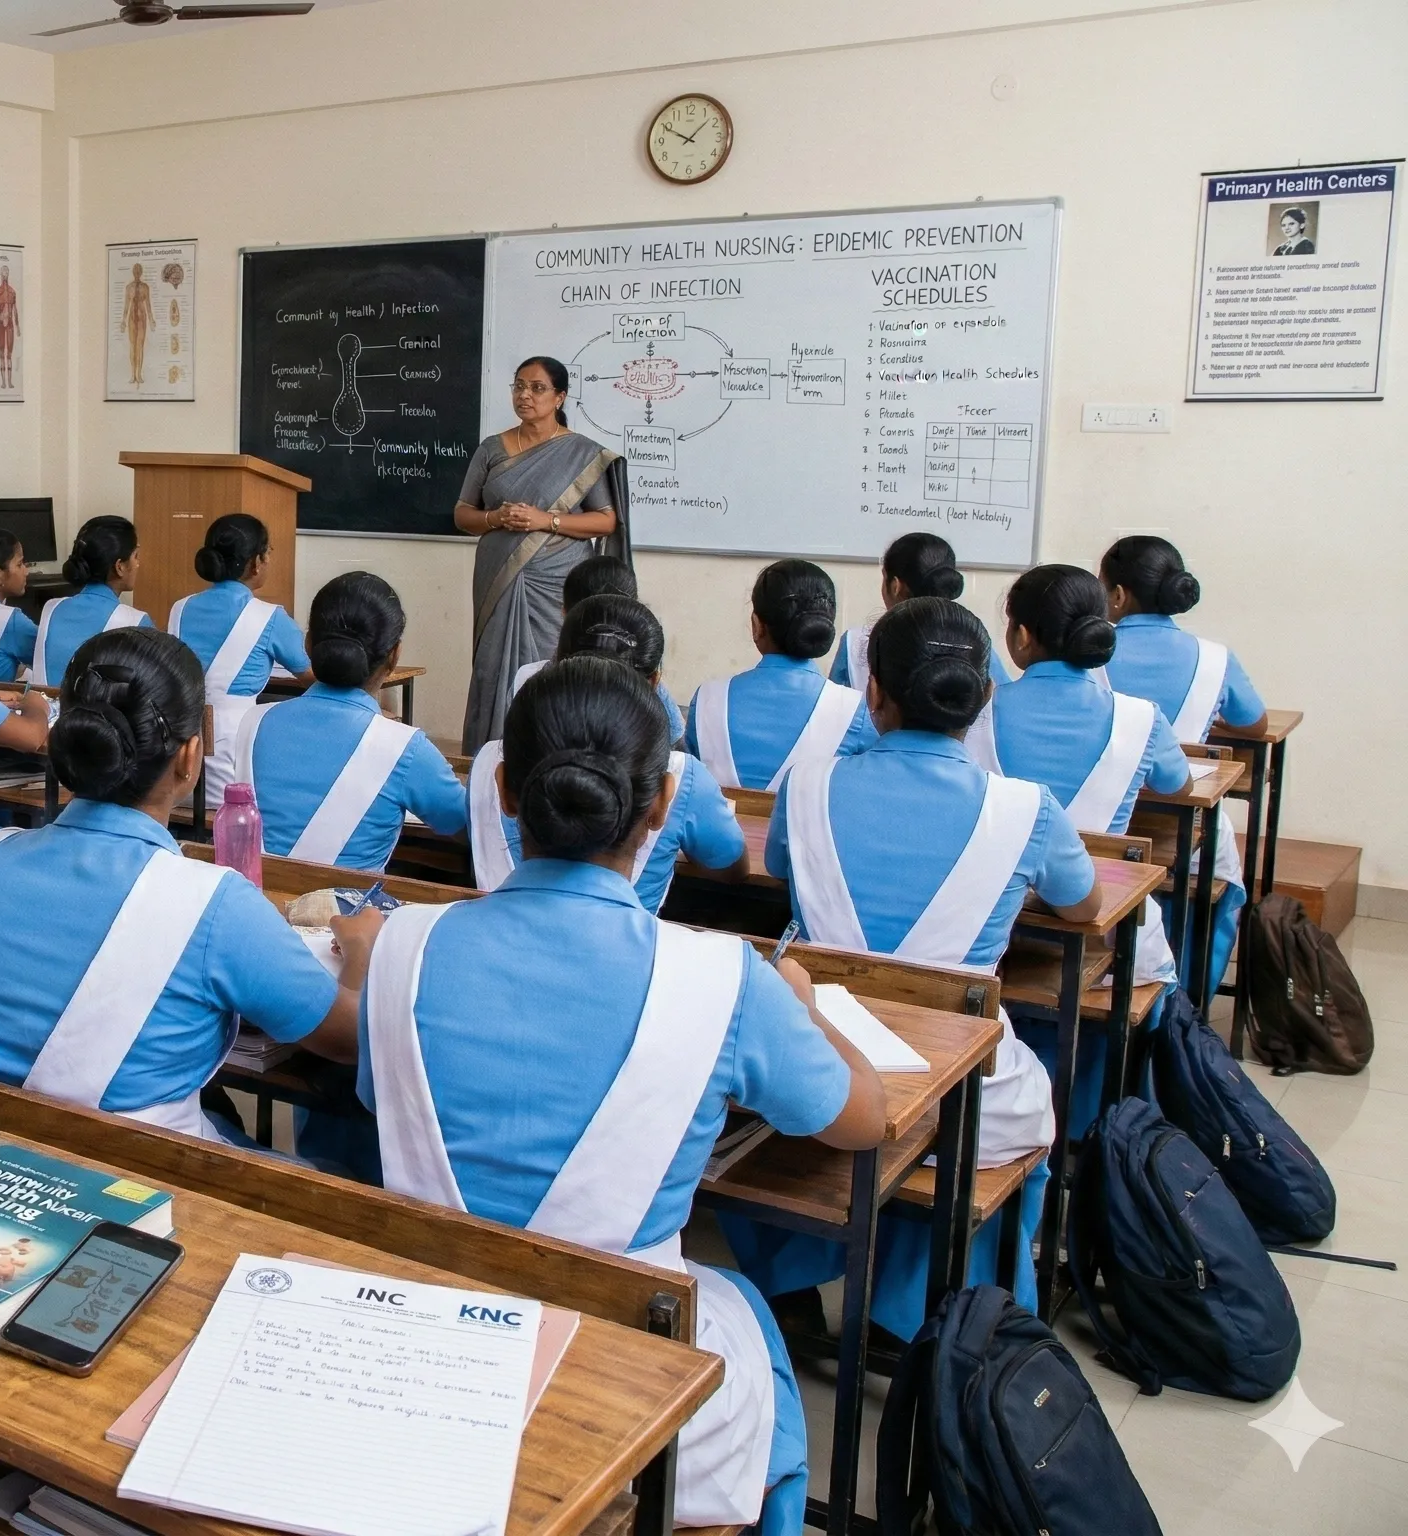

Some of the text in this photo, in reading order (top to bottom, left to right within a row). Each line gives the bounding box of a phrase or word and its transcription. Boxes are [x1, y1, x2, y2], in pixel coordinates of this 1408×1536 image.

[685, 104, 696, 115] 12
[672, 110, 681, 122] 11
[711, 118, 719, 128] 2
[658, 137, 665, 147] 9
[715, 132, 722, 143] 3
[661, 151, 668, 161] 8
[710, 148, 717, 157] 4
[671, 161, 679, 172] 7
[685, 165, 692, 175] 6
[699, 160, 707, 170] 5
[1215, 172, 1387, 197] Primary Health Centers
[535, 245, 633, 269] COMMUNITY
[642, 241, 705, 262] HEALTH
[813, 230, 893, 253] EPIDEMIC
[904, 222, 1023, 248] PREVENTION
[871, 263, 996, 286] VACCINATION
[561, 278, 741, 303] CHAIN OF INFECTION
[882, 285, 988, 306] SCHEDULES
[392, 301, 440, 317] Infection
[986, 367, 1039, 379] Schedules
[876, 480, 898, 493] Tell
[356, 1287, 407, 1306] INC
[459, 1304, 523, 1326] KNC
